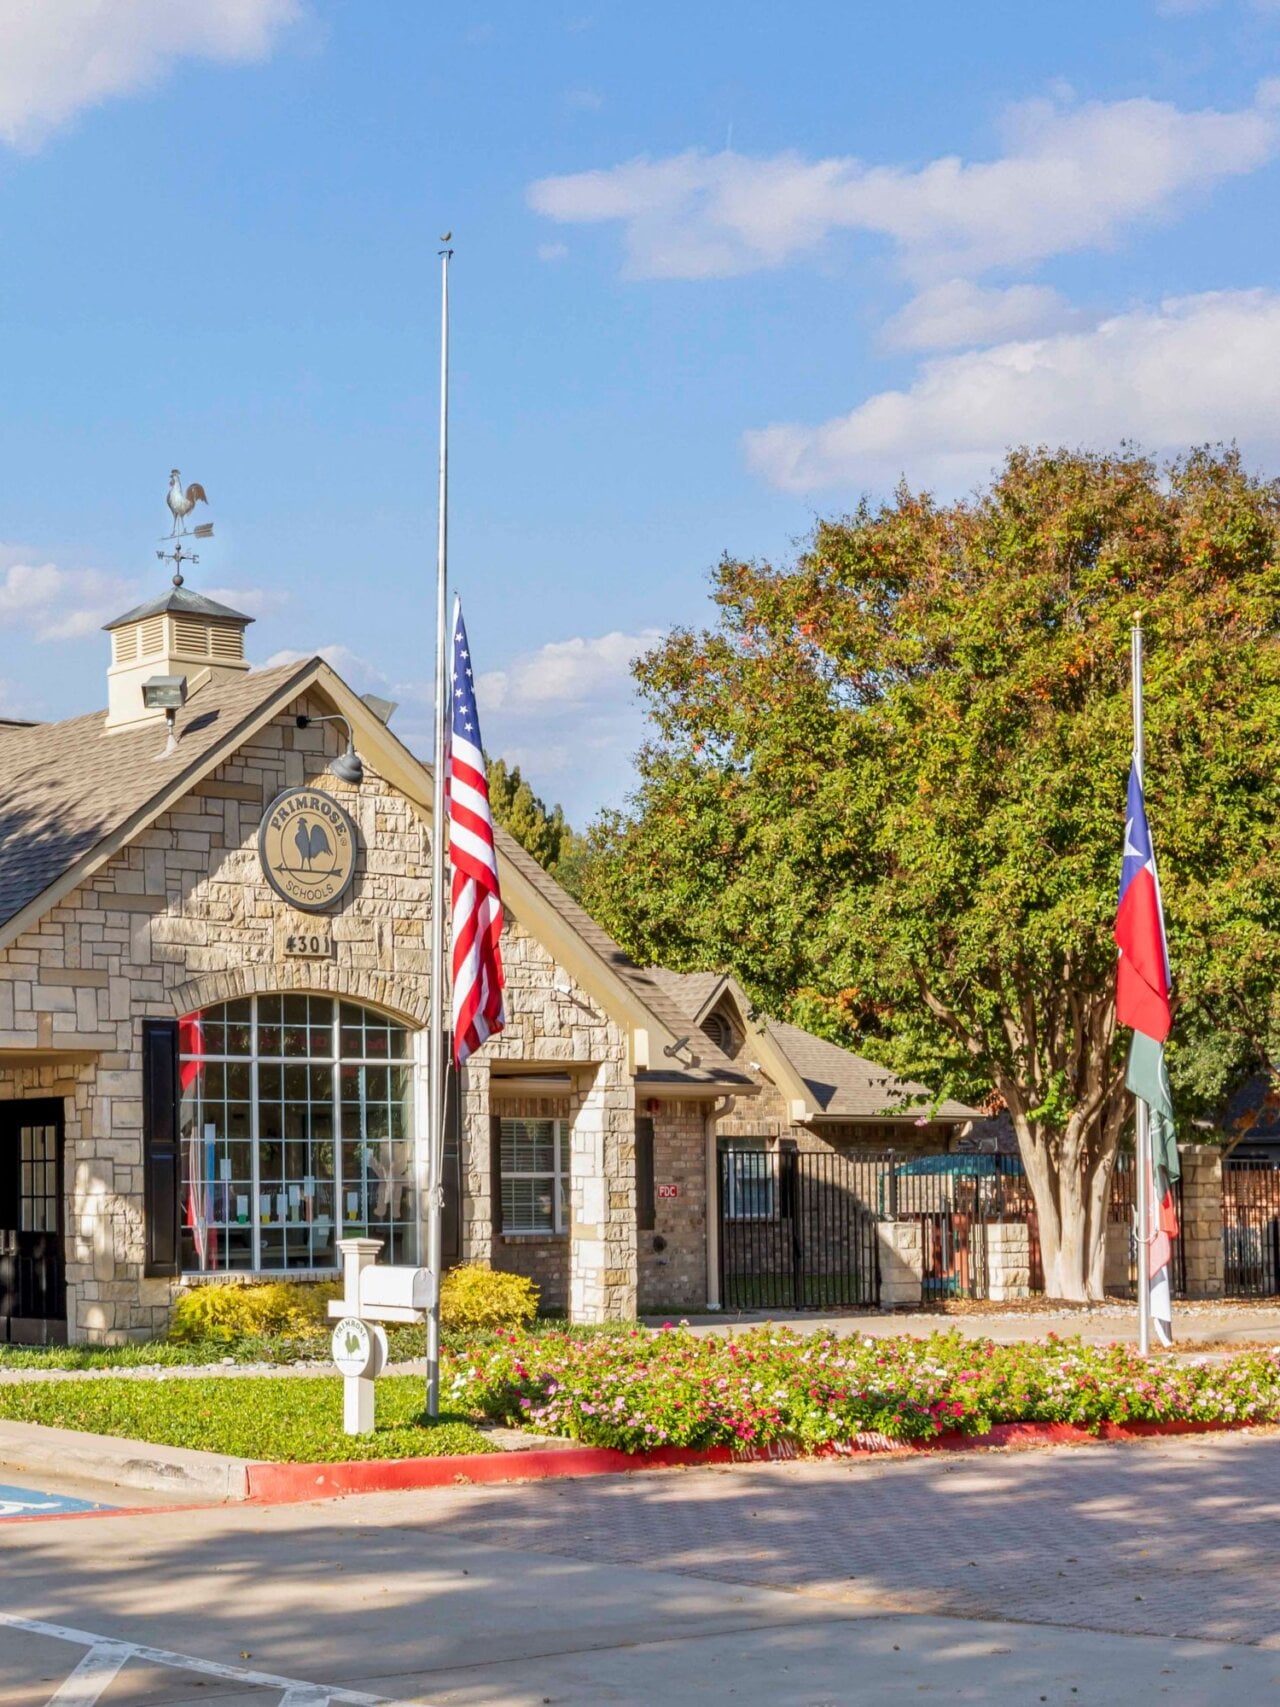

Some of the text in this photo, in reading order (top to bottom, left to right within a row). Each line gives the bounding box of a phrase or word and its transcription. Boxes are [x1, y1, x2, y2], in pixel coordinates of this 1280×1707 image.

[271, 796, 347, 836] PRIMROSE
[286, 881, 333, 900] SCHOOLS
[660, 1186, 675, 1196] FDC
